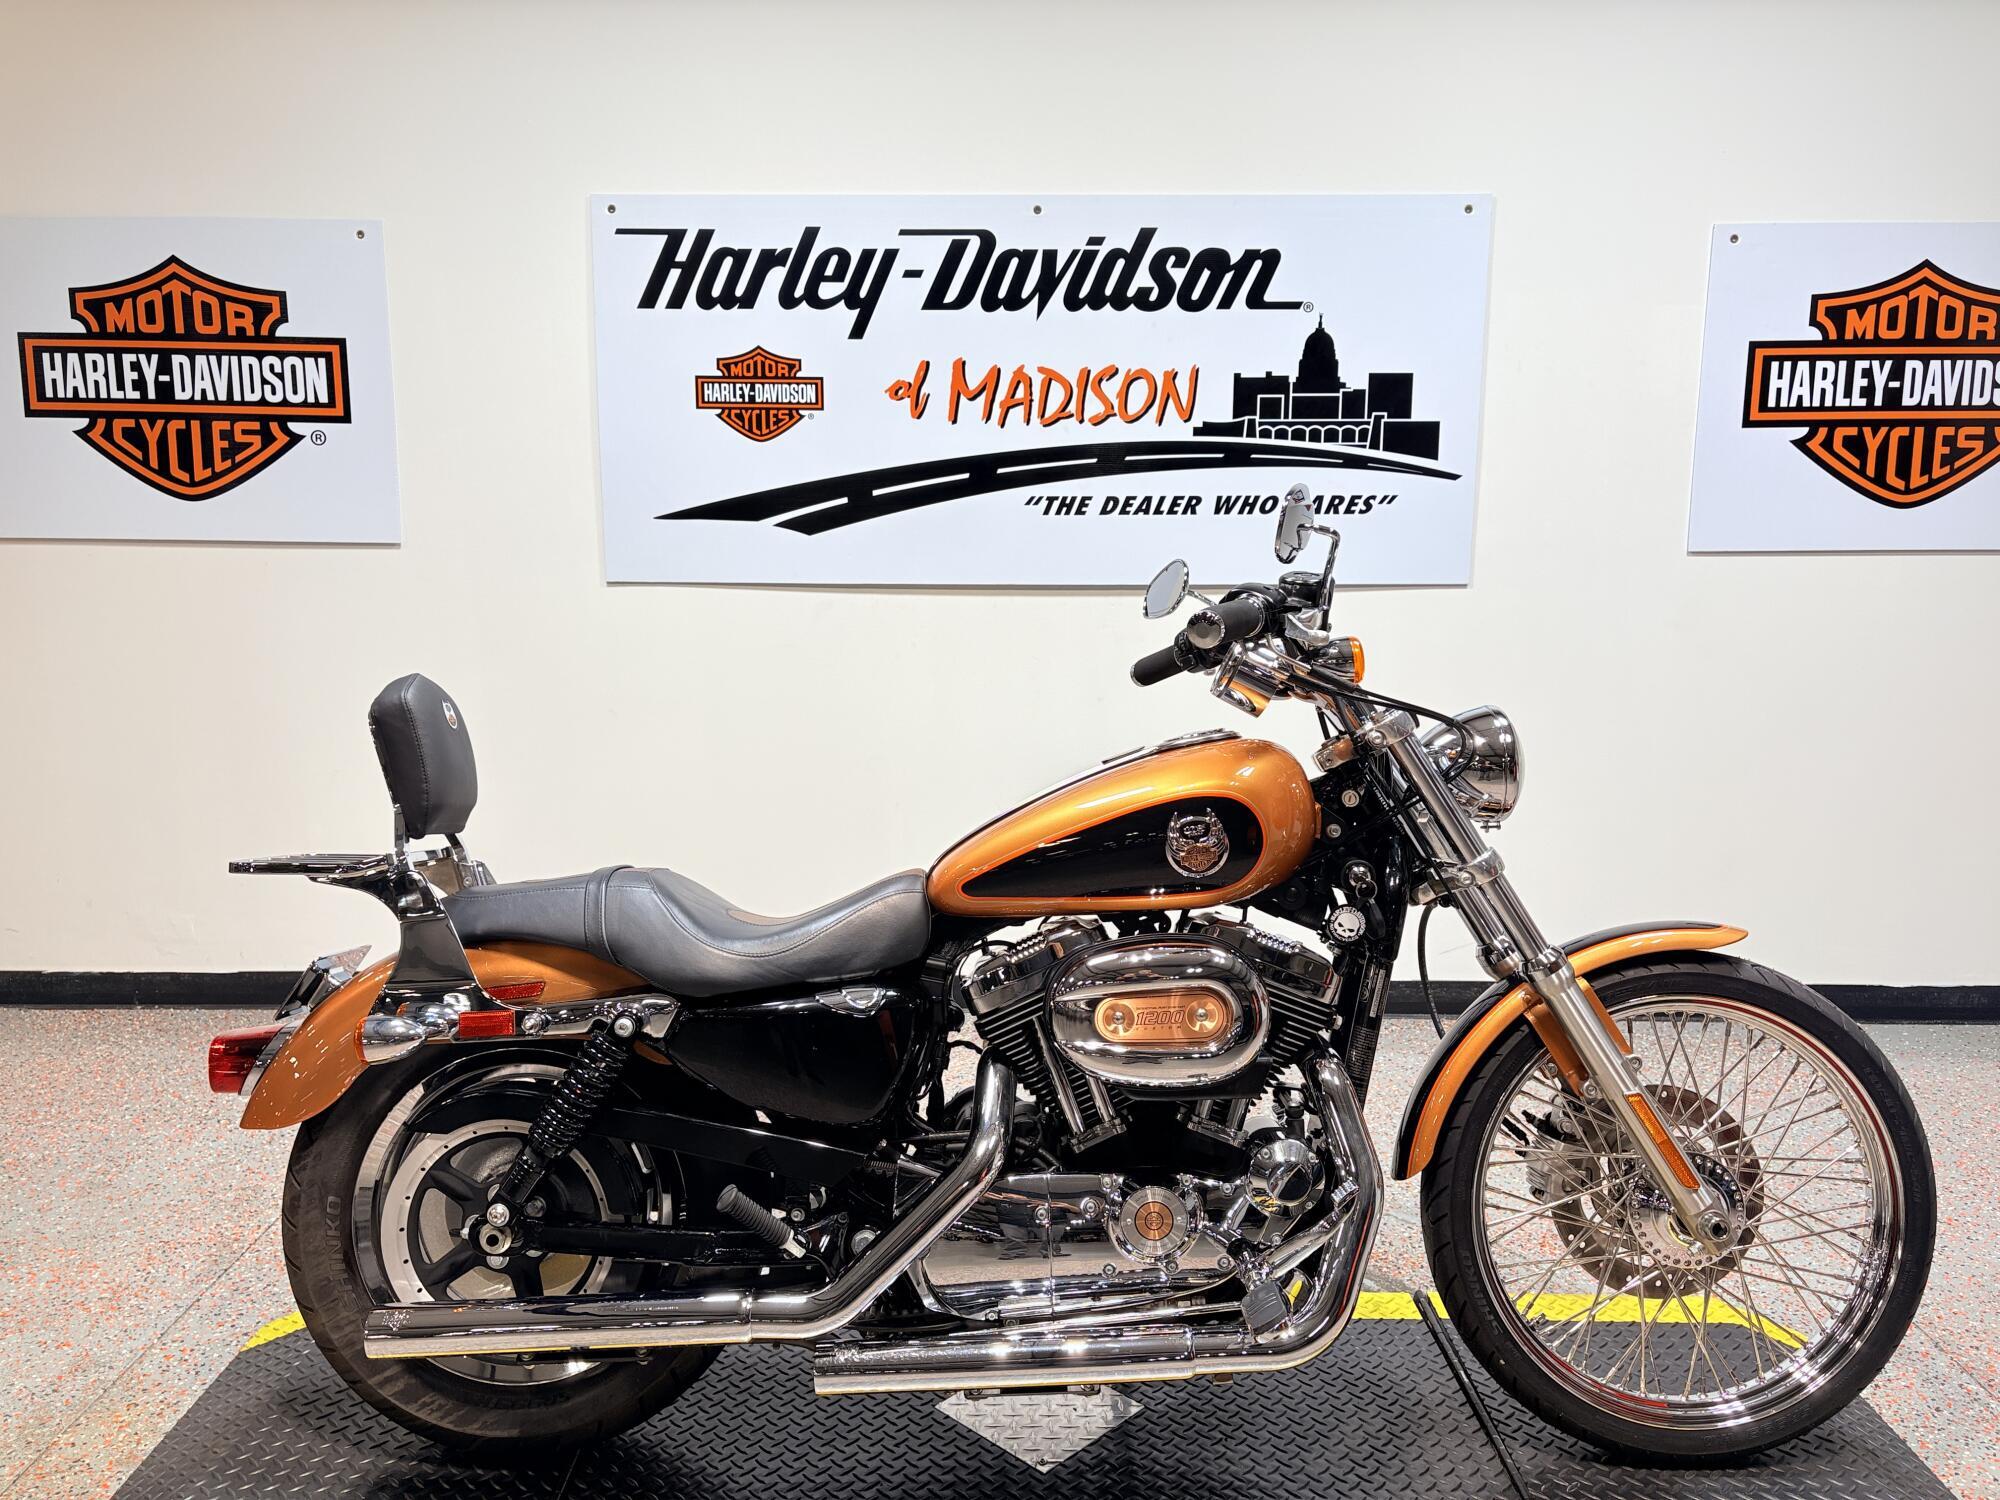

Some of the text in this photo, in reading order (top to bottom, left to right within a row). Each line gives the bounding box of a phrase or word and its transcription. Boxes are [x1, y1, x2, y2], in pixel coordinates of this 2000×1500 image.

[104, 279, 255, 336] MOTOR
[614, 226, 1303, 340] Harley-Davidson
[1844, 283, 1998, 341] MOTOR
[42, 352, 329, 404] HARLEY-DAVIDSON
[730, 354, 789, 377] MOTOR
[884, 356, 1200, 429] of MADISON
[703, 382, 817, 404] HARLEY-DAVIDSON
[730, 409, 790, 436] CYCLES
[112, 418, 262, 483] CYCLES
[1832, 426, 1985, 491] CYCLES
[1099, 495, 1202, 516] DEALER
[1213, 494, 1279, 516] WHO
[1135, 1009, 1185, 1026] 1200
